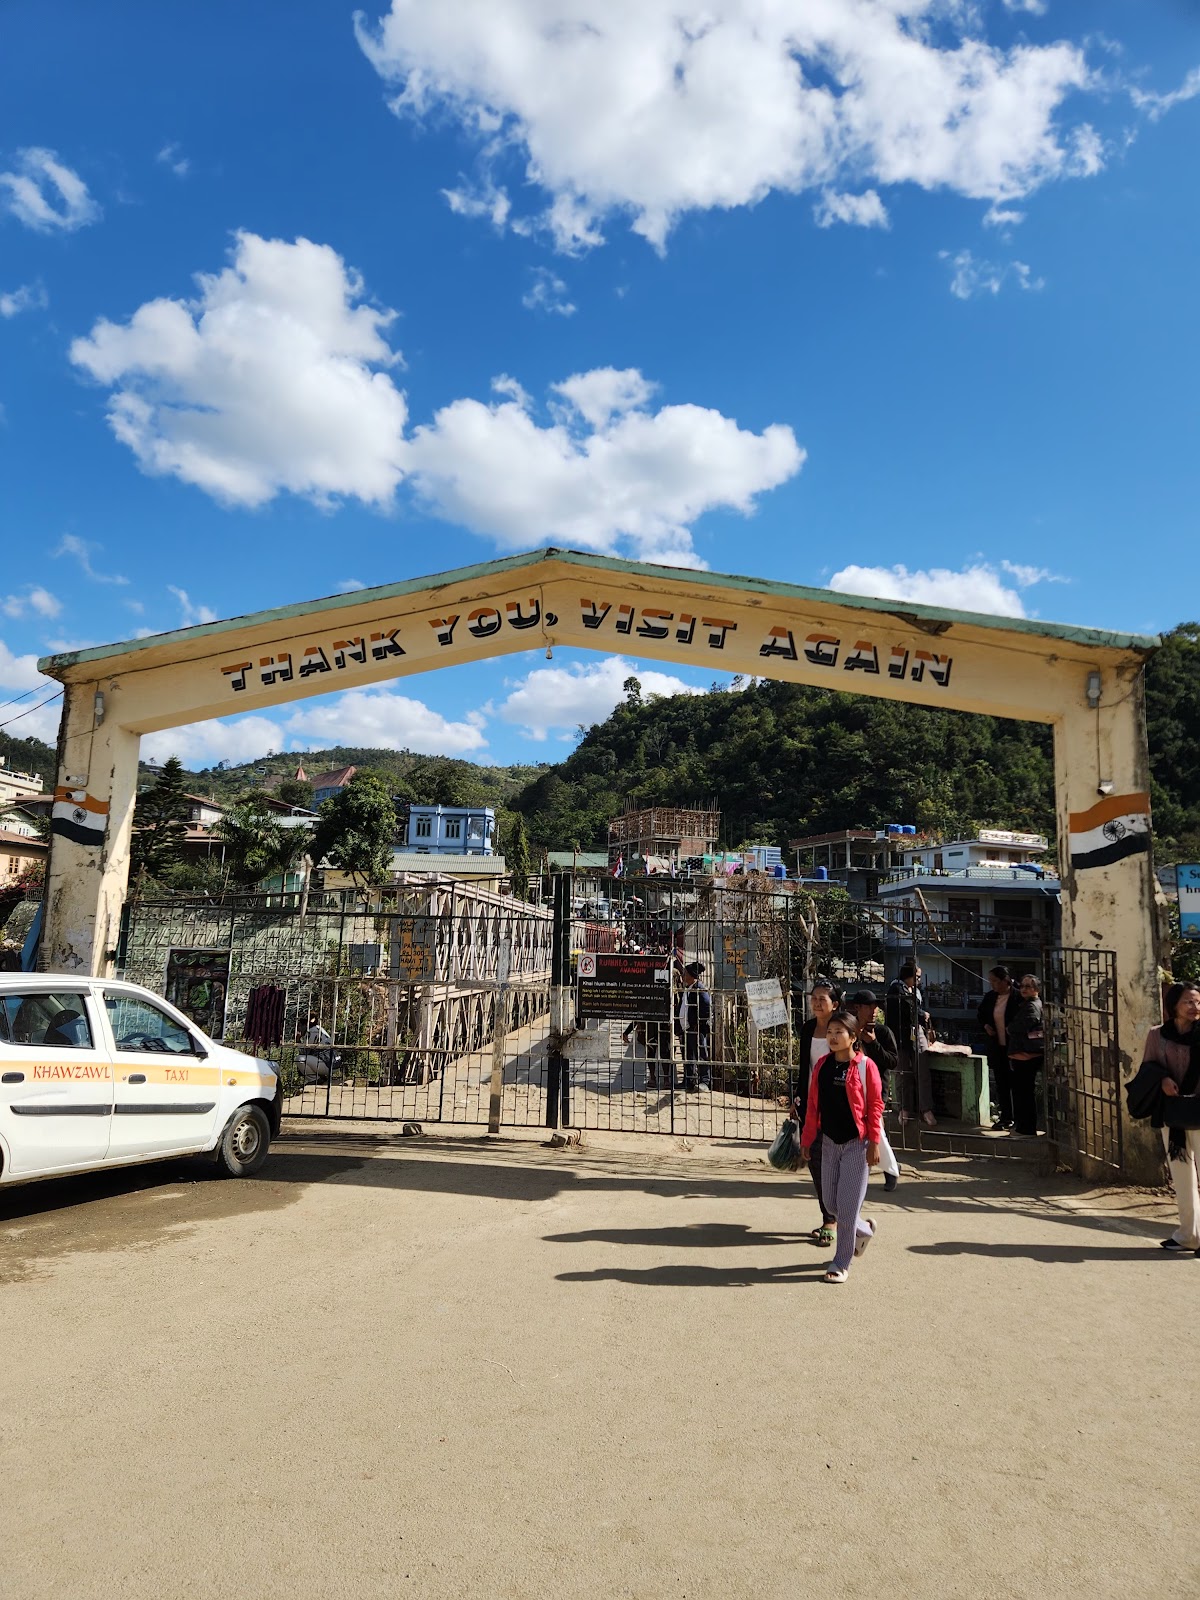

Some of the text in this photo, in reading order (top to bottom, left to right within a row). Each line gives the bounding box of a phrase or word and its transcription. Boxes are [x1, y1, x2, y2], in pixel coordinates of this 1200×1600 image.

[220, 598, 953, 692] THANK YOU, VISIT AGAIN
[33, 1065, 189, 1082] KHAWZAWL TAXI
